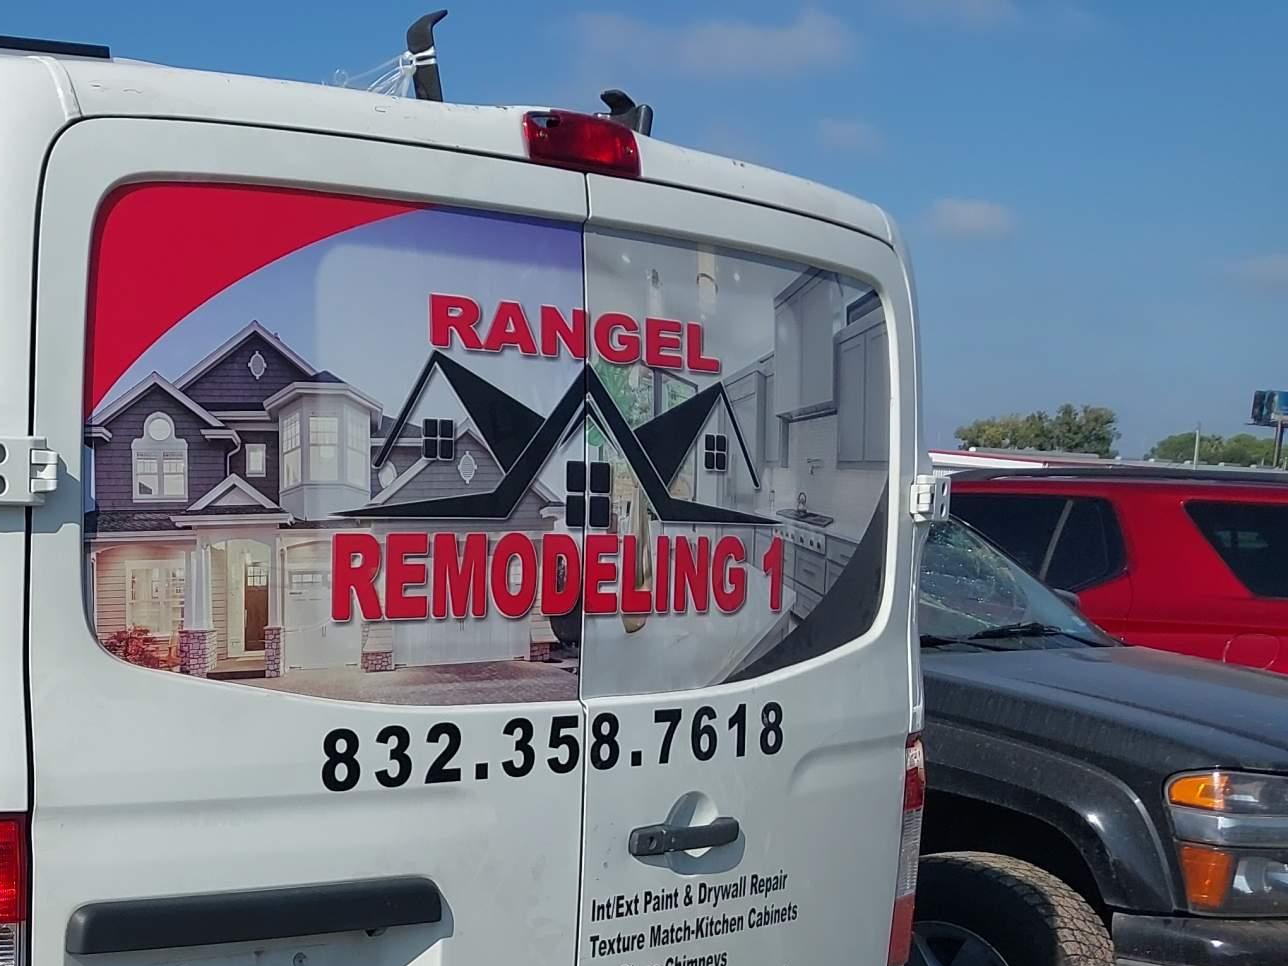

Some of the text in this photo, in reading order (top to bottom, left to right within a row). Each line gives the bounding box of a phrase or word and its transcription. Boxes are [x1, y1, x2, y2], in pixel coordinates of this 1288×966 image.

[428, 292, 722, 374] RANGEL
[330, 531, 784, 623] REMODELING 1
[321, 701, 785, 793] 832.358.7618
[590, 902, 798, 958] Texture Match-Kitchen Cabinets
[591, 869, 788, 922] Int/Ext Paint & Drywall Repair
